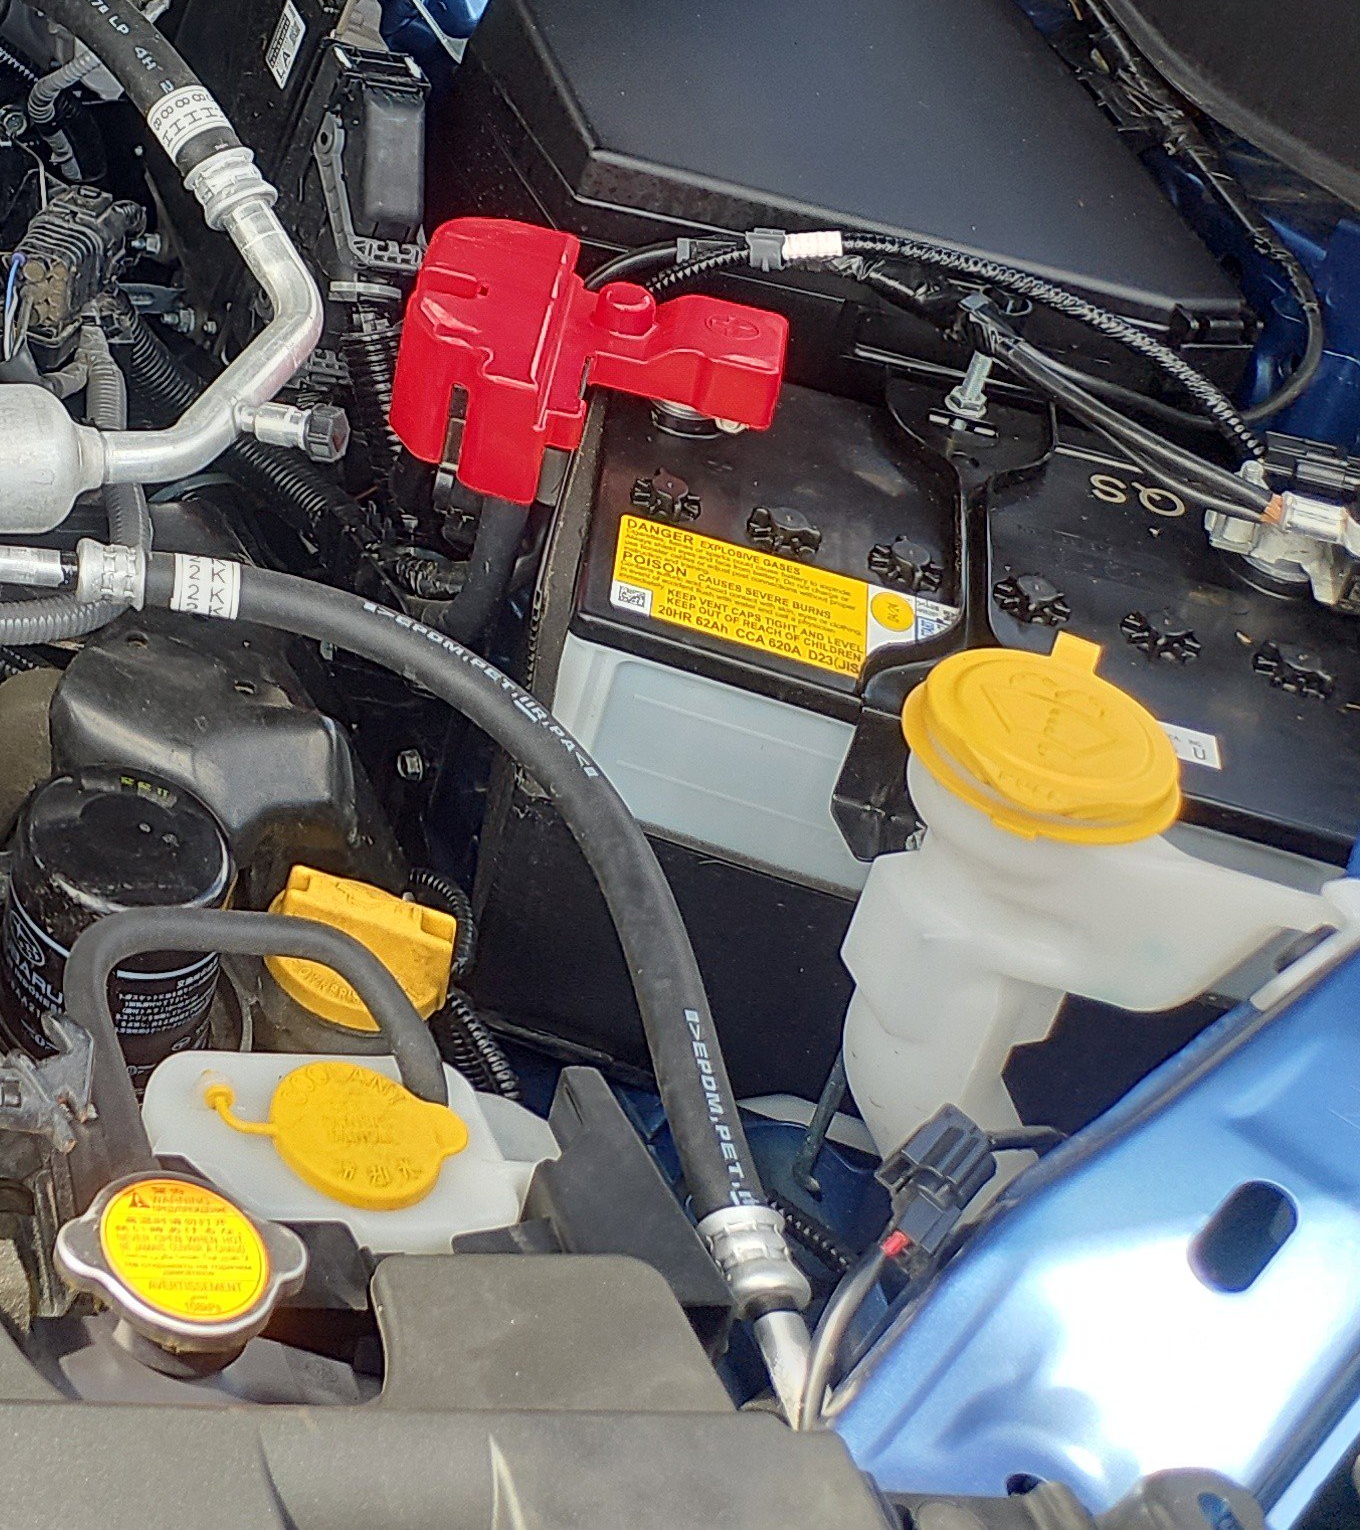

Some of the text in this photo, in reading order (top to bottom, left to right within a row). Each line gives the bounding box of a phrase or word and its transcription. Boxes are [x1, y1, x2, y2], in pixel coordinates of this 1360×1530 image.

[109, 16, 130, 35] LP
[189, 564, 225, 583] 2 K
[626, 517, 801, 576] DANGER EXPLOSIVE GASES
[187, 584, 224, 604] 2 K
[622, 549, 831, 619] POISON CAUSES SEVERE BURNS
[657, 603, 692, 624] 20HR
[694, 614, 729, 635] 62Ah
[735, 627, 766, 646] CCA
[768, 636, 802, 657] 620A
[666, 595, 860, 662] KEEP OUT OF REACH OF CHILDREN
[667, 587, 861, 653] KEEP VENT CAPS TIGHT AND LEVEL
